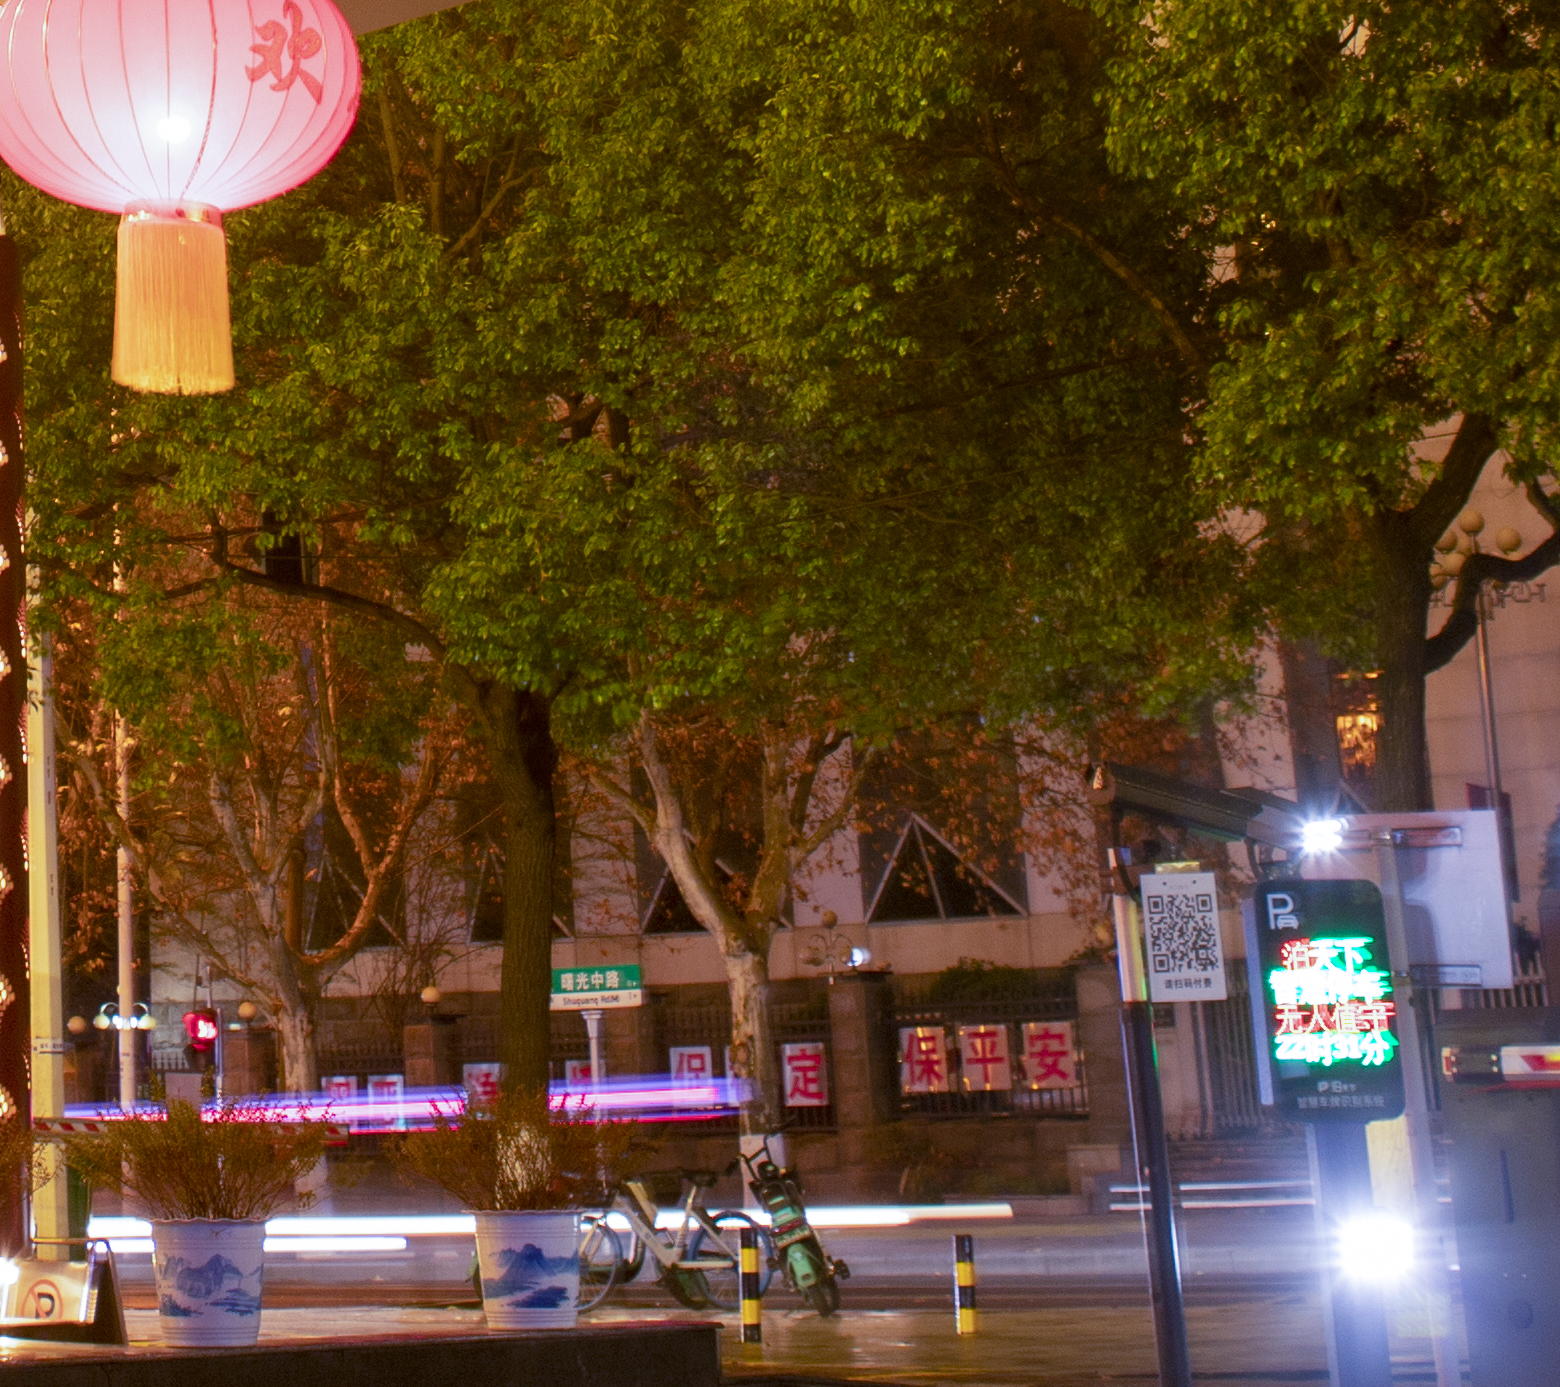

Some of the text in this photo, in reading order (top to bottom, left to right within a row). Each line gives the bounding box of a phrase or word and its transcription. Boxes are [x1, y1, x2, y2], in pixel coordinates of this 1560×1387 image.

[244, 0, 323, 105] 欢
[561, 971, 619, 991] 曙光中路
[1276, 1000, 1396, 1035] 无人值守
[904, 1028, 1070, 1085] 保平安
[1274, 1030, 1399, 1067] 22时31分
